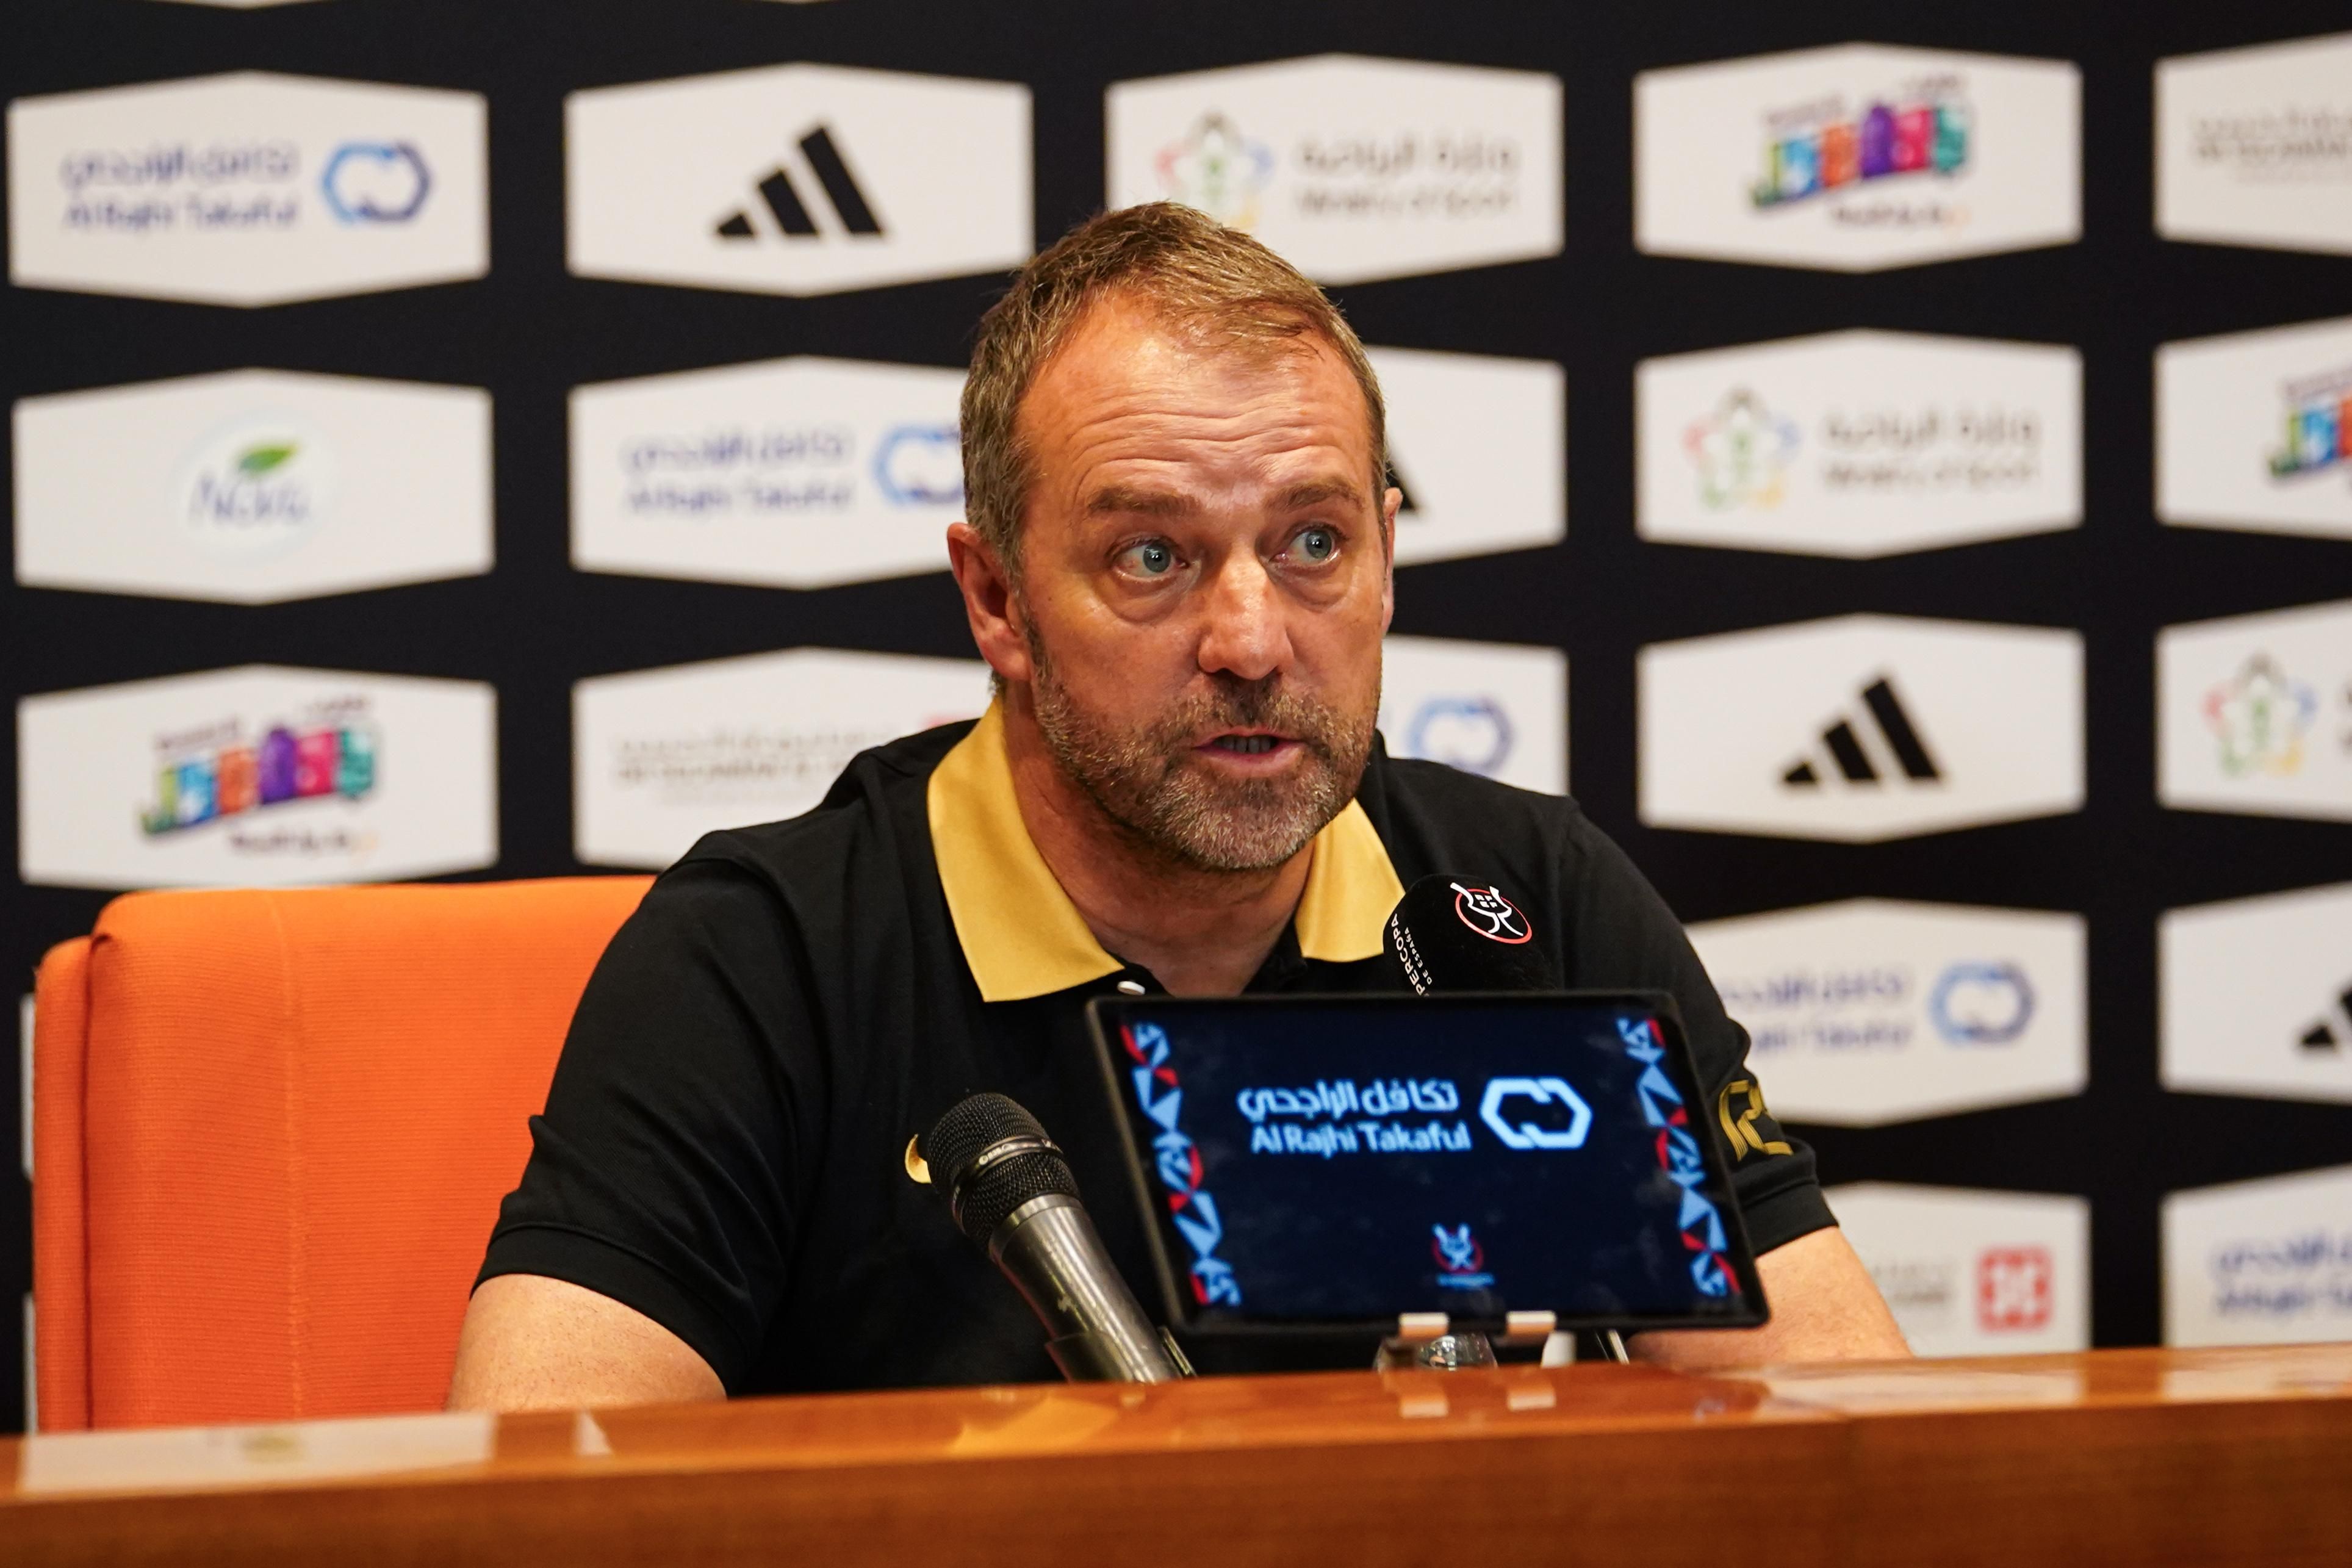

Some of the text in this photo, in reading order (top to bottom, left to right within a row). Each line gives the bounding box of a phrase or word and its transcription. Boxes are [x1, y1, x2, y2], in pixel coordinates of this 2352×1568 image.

[1391, 913, 1430, 997] PERCOPA
[1422, 969, 1433, 985] DE
[1237, 1076, 1461, 1124] تكافل الراجحي
[1251, 1120, 1473, 1160] Al Rajhi Takaful
